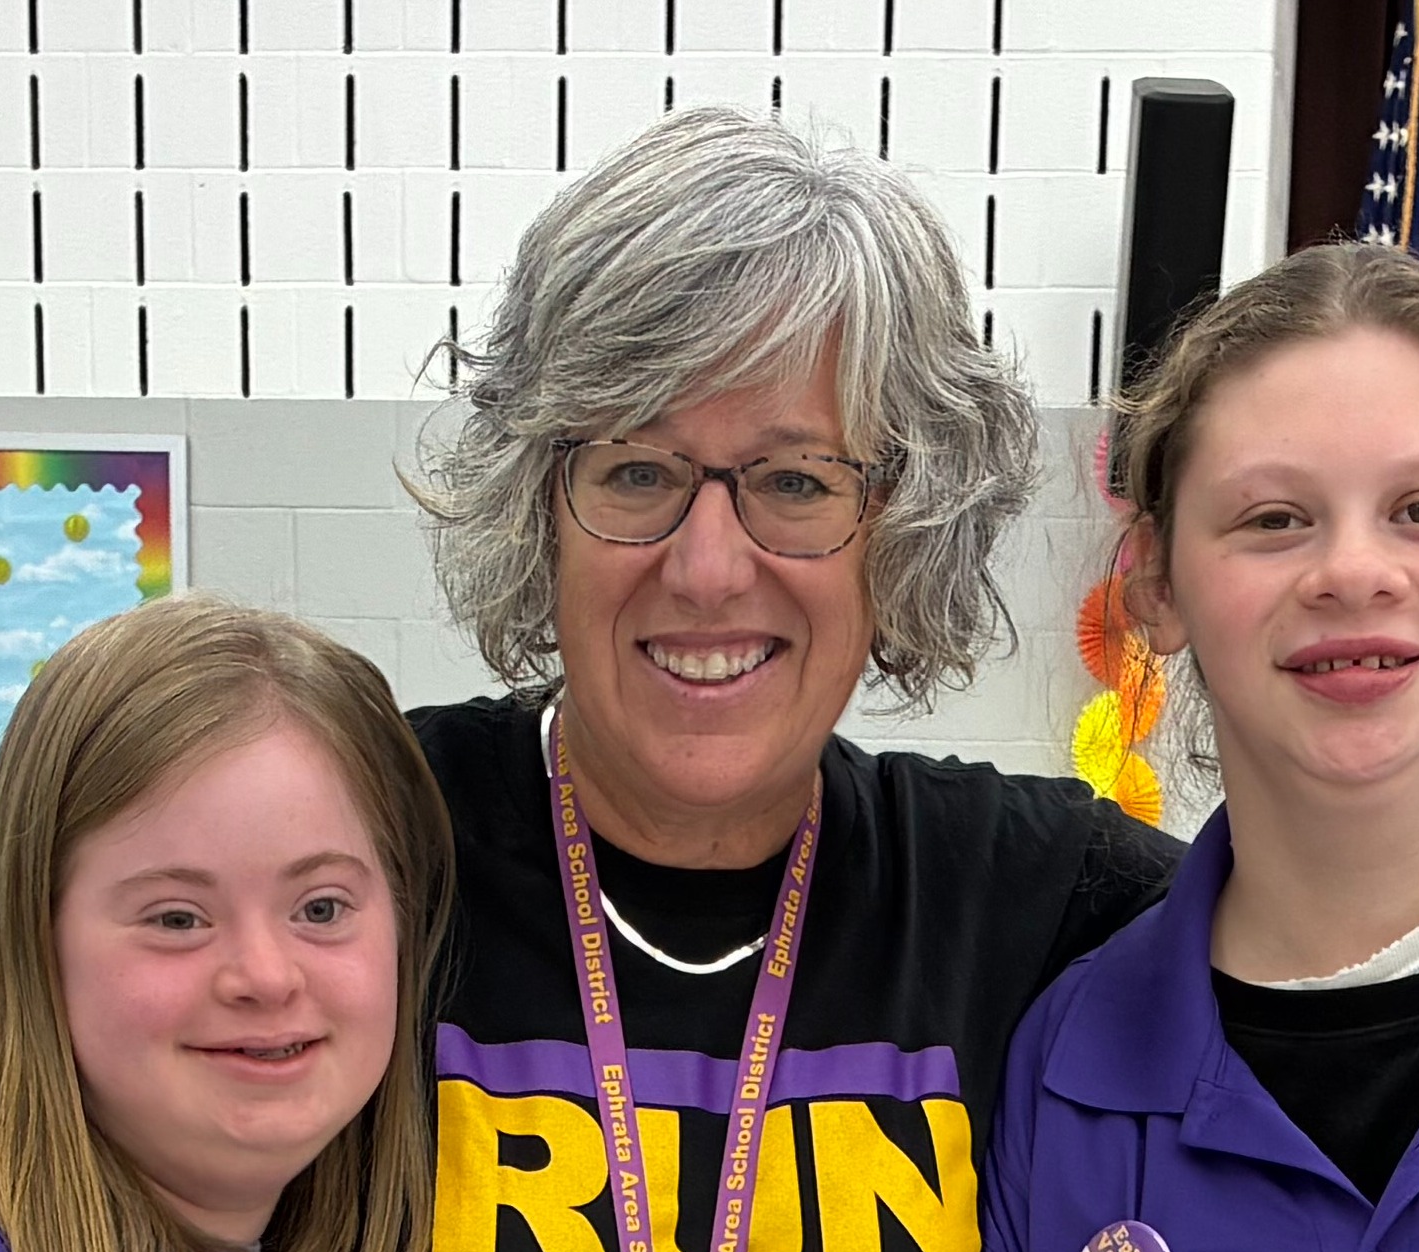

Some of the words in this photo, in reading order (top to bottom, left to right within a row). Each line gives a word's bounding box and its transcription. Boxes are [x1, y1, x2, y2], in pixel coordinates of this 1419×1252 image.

[558, 783, 579, 837] Area
[567, 843, 598, 926] School
[767, 889, 801, 978] Ephrata
[791, 830, 814, 886] Area
[581, 932, 614, 1026] District
[740, 1012, 776, 1100] District
[601, 1064, 633, 1163] Ephrata
[619, 1170, 640, 1232] Area
[726, 1108, 756, 1191] School
